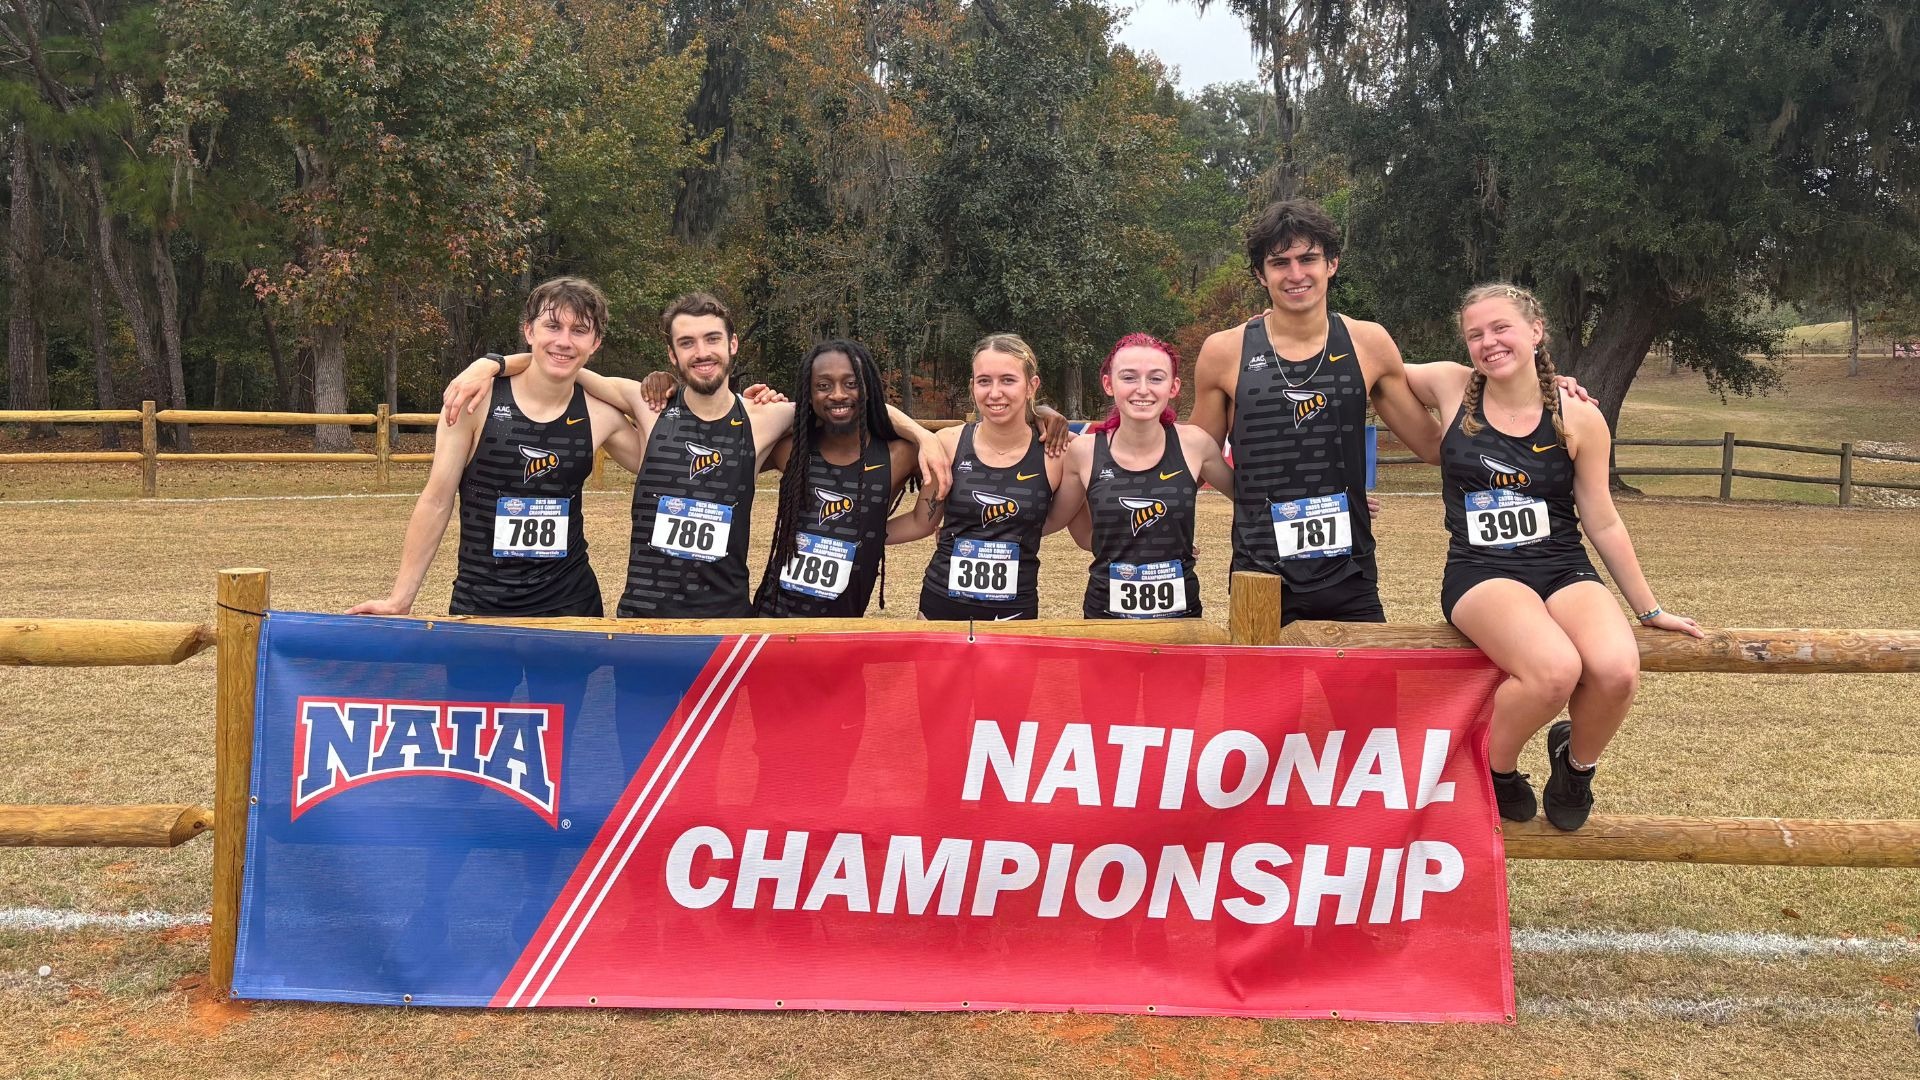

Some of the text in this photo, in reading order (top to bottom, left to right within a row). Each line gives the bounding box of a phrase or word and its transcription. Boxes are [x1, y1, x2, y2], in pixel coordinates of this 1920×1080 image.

[509, 519, 556, 547] 788
[666, 517, 716, 551] 786
[1290, 516, 1337, 550] 787
[1478, 508, 1538, 542] 390
[791, 554, 839, 588] 789
[957, 559, 1007, 591] 388
[1120, 582, 1175, 611] 389
[297, 702, 555, 813] NAIA
[961, 719, 1456, 811] NATIONAL
[665, 825, 1465, 926] CHAMPIONSHIP
